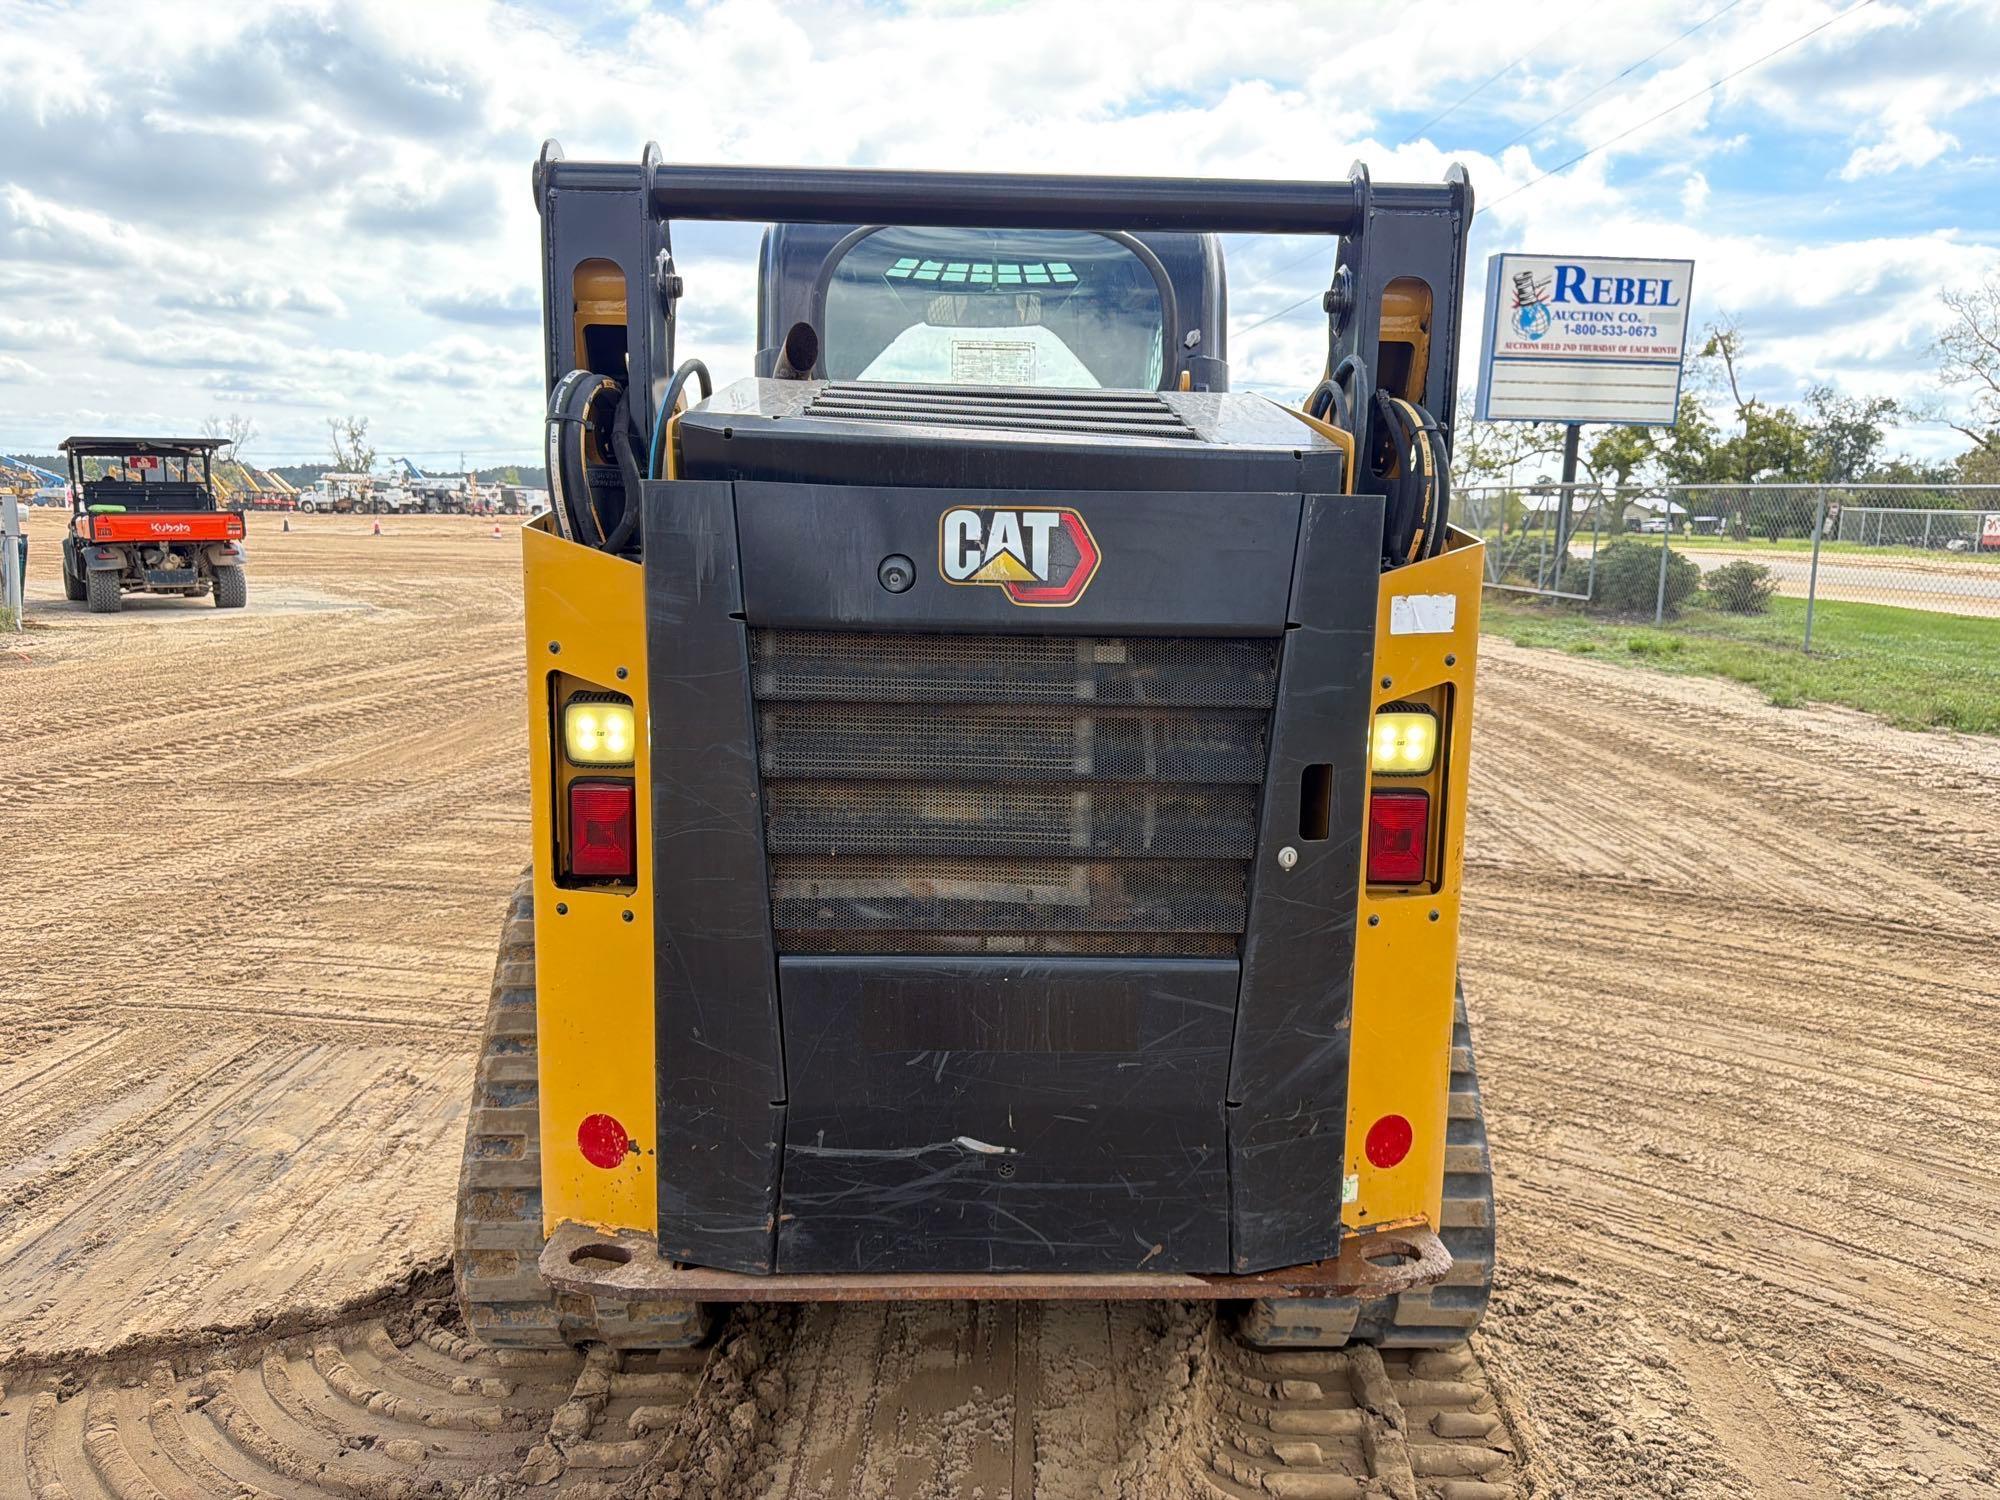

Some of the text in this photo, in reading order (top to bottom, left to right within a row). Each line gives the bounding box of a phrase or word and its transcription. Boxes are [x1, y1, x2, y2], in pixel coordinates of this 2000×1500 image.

[1551, 265, 1681, 307] REBEL
[1551, 310, 1642, 323] AUCTION CO.
[1564, 324, 1658, 337] 1-800-533-0673
[1504, 342, 1540, 350] AUCTIONS
[1562, 343, 1577, 351] 2ND
[1579, 344, 1617, 352] THURSDAY
[1630, 345, 1649, 353] EACH
[1651, 346, 1678, 354] MONTH
[150, 522, 191, 532] Kubota
[944, 509, 1060, 581] CAT
